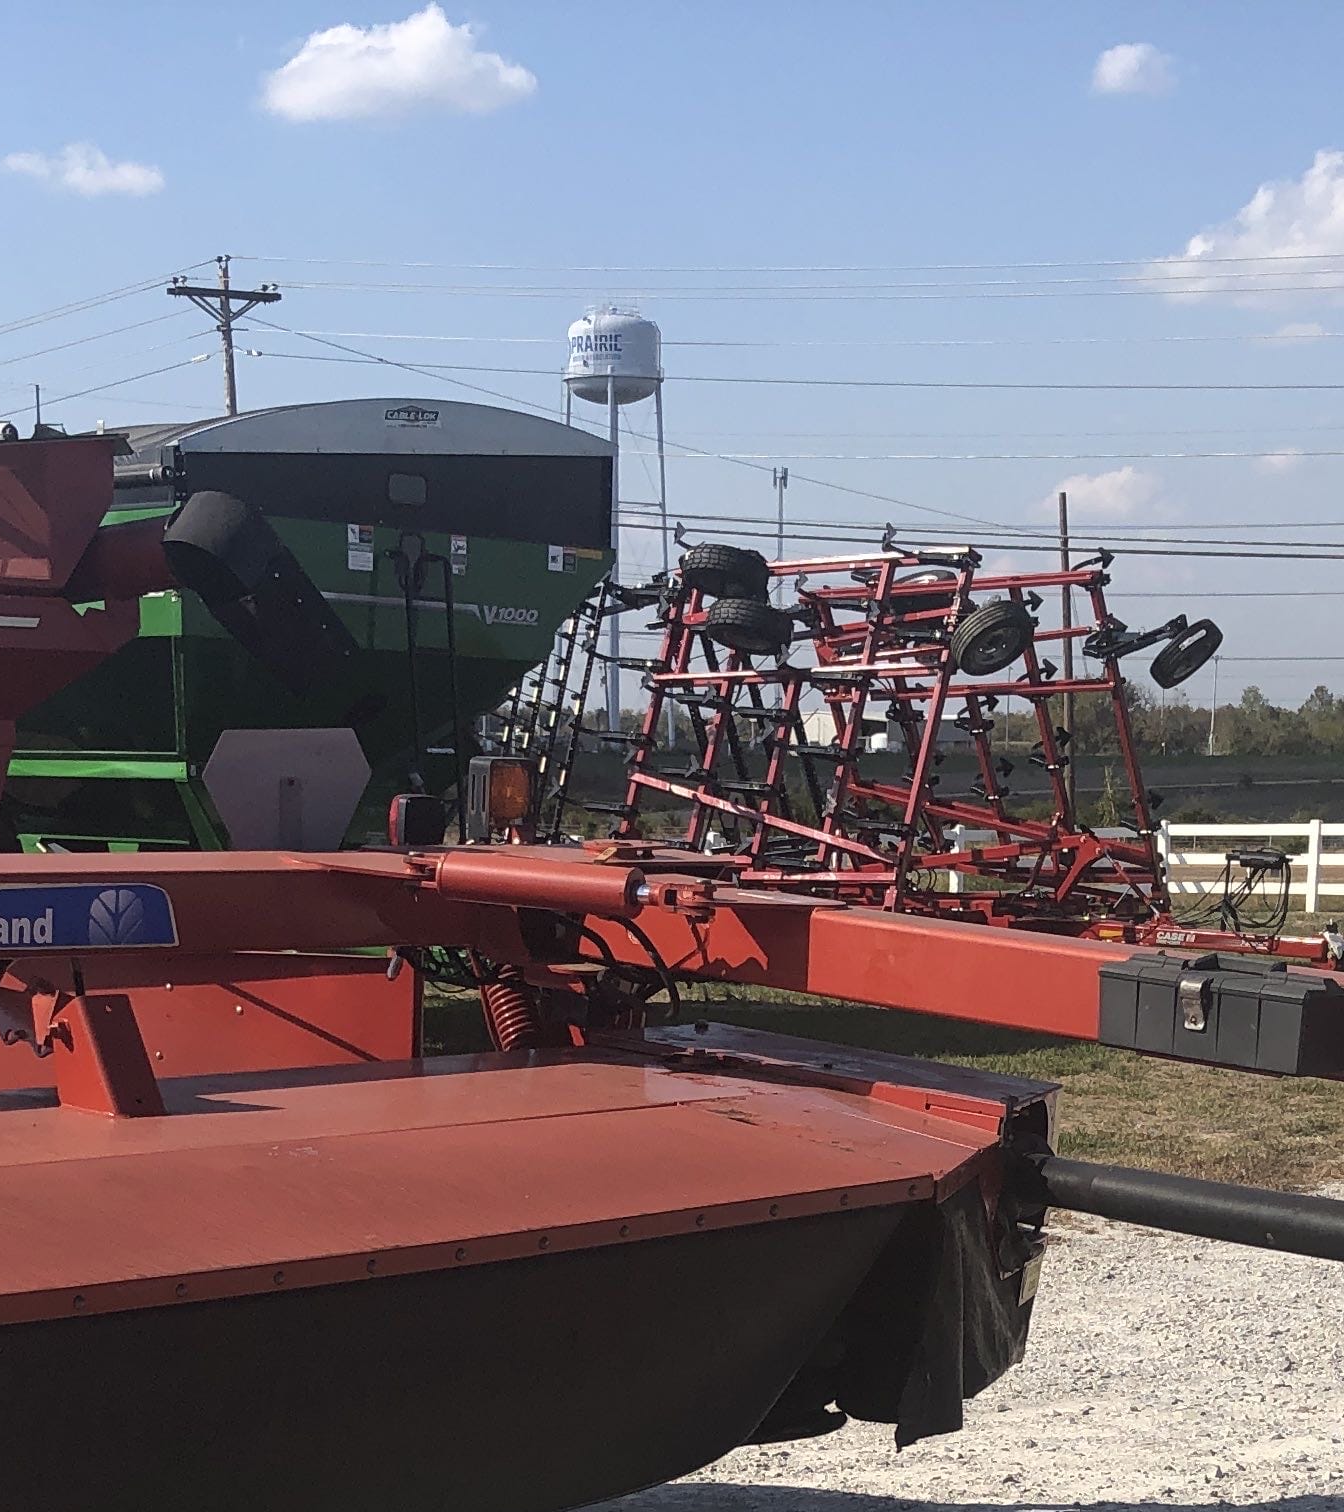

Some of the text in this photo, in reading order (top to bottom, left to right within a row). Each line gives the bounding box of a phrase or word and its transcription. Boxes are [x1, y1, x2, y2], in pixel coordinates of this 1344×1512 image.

[571, 334, 623, 353] PRAIRIE
[483, 605, 539, 625] V1000
[1156, 931, 1186, 941] CASE
